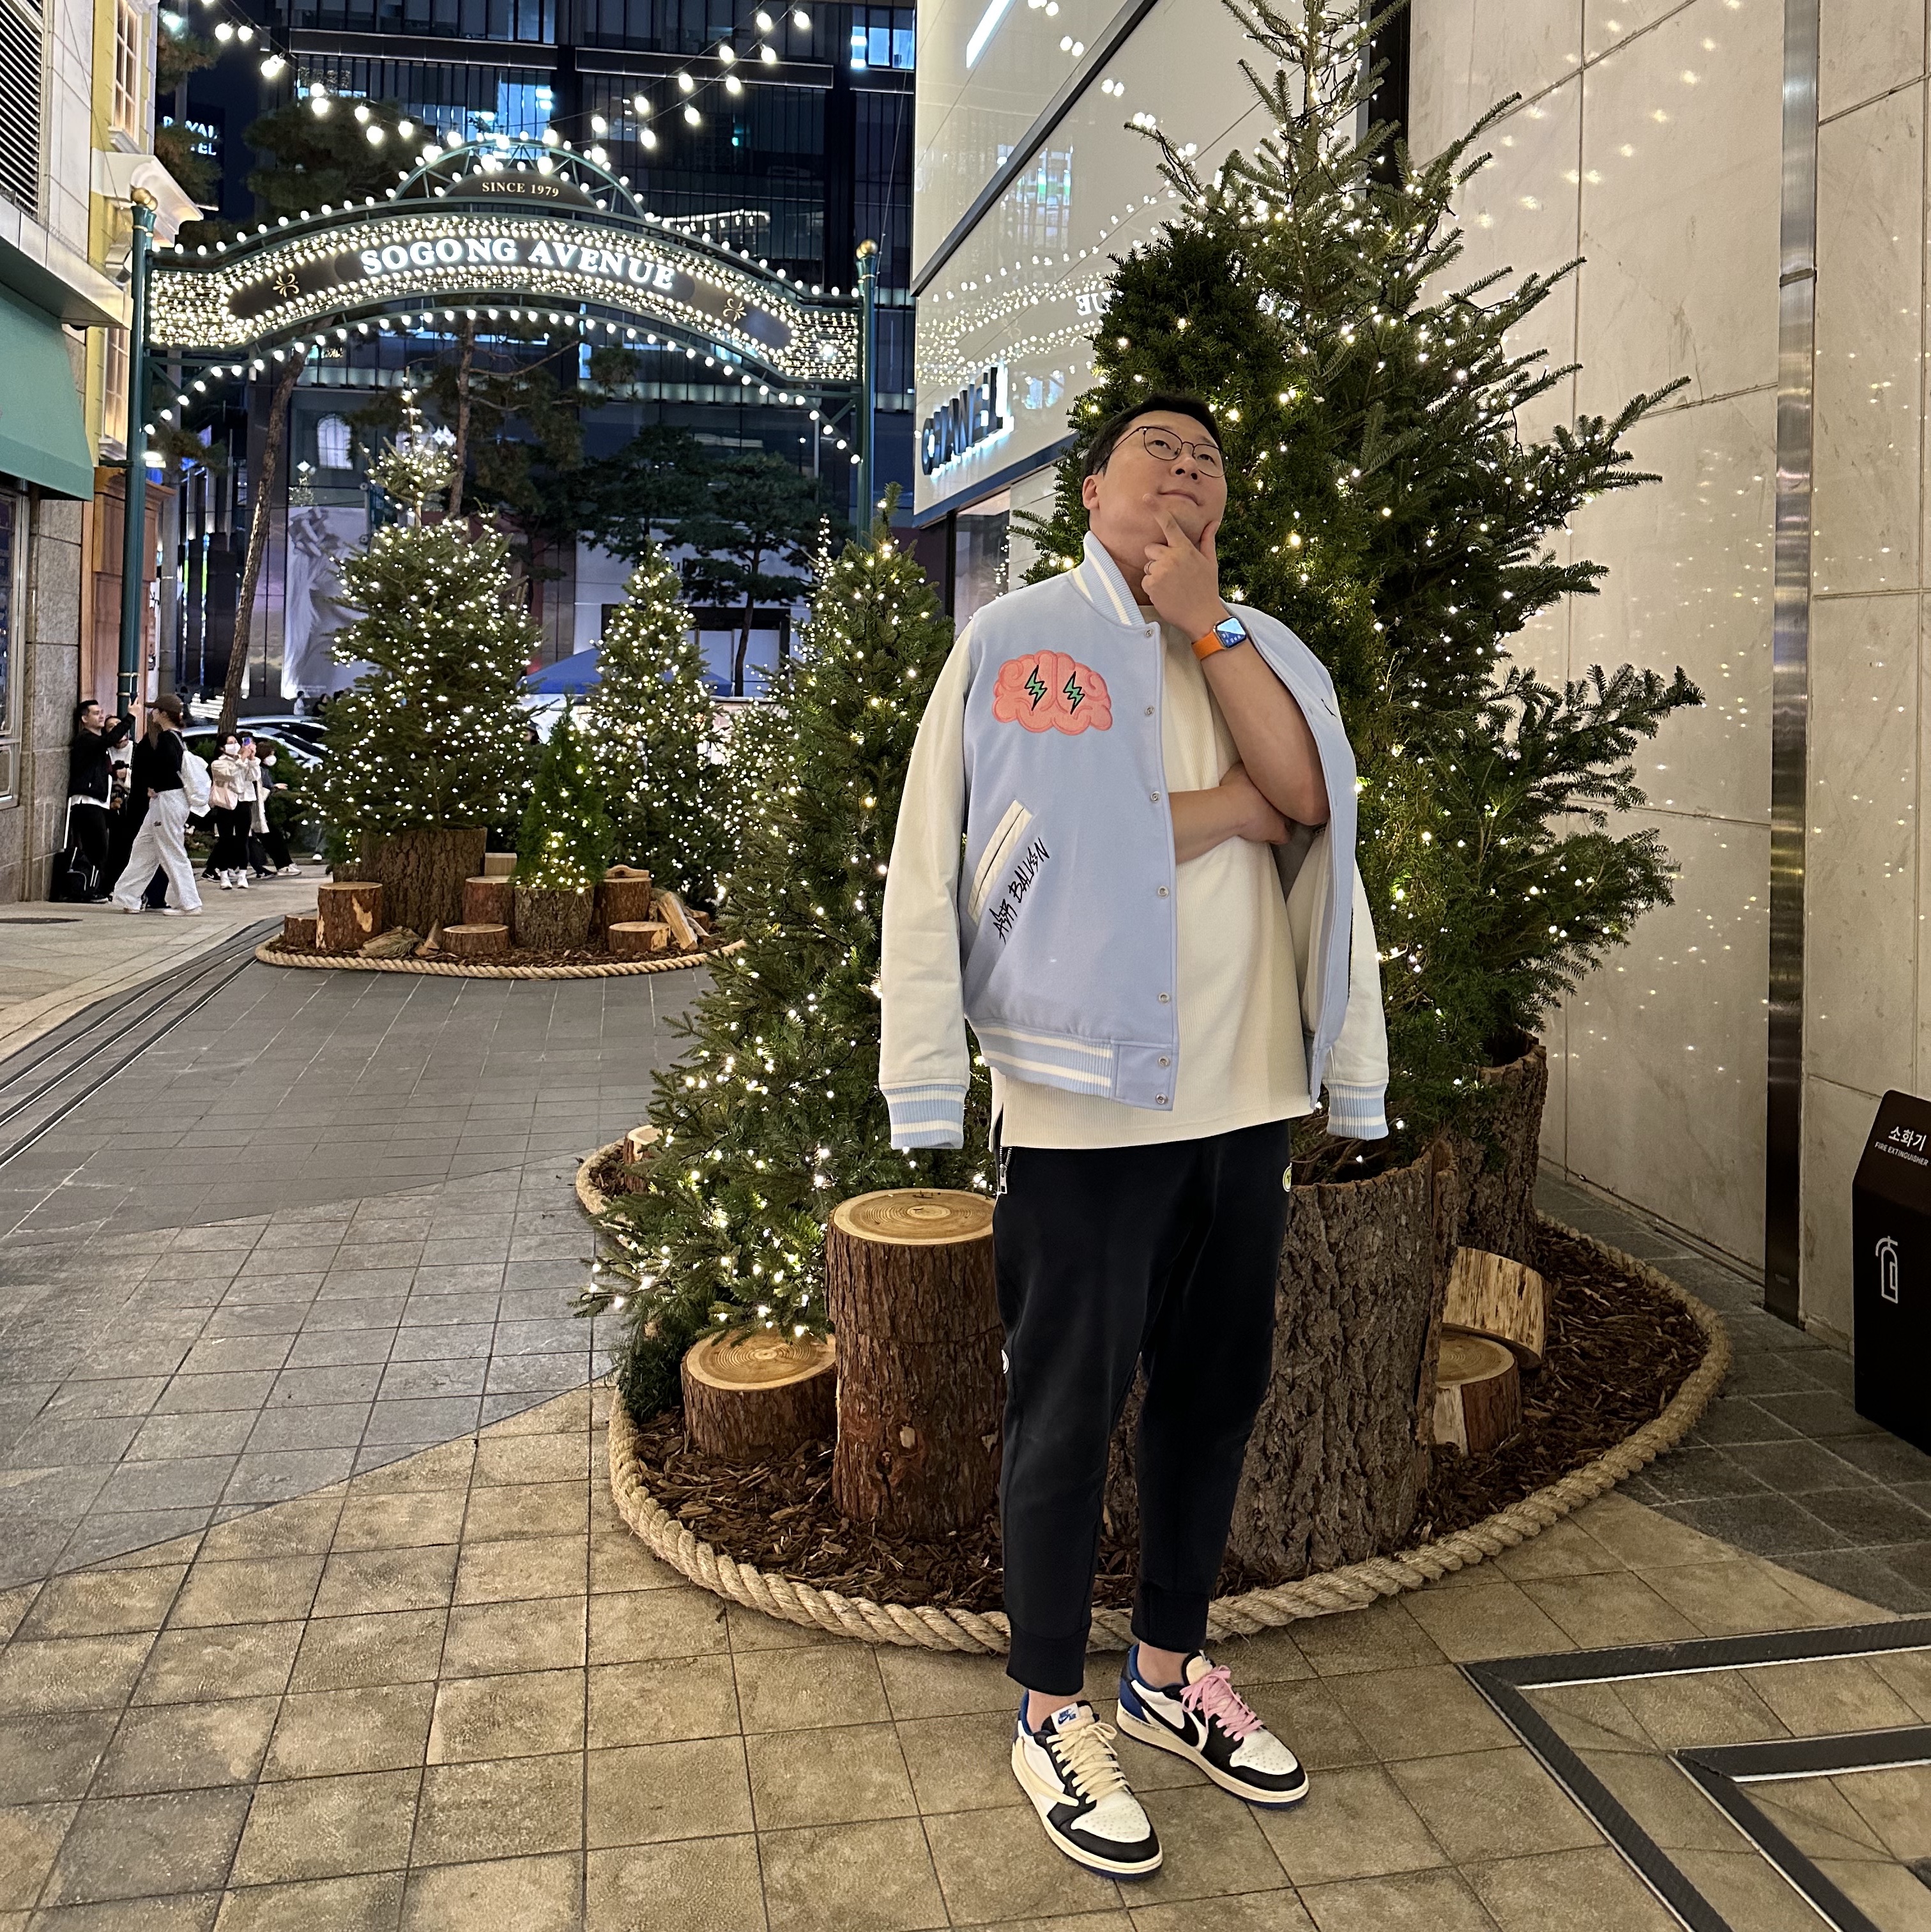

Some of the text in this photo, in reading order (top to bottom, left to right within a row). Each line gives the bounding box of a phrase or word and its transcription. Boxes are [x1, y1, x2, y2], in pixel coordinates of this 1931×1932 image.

[163, 116, 217, 139] RYAL
[482, 182, 559, 197] SINCE 1979
[360, 238, 675, 289] SOGONG AVENUE
[1888, 1126, 1927, 1152] 소화기
[1874, 1142, 1929, 1167] FIRE EXTINGUISHER
